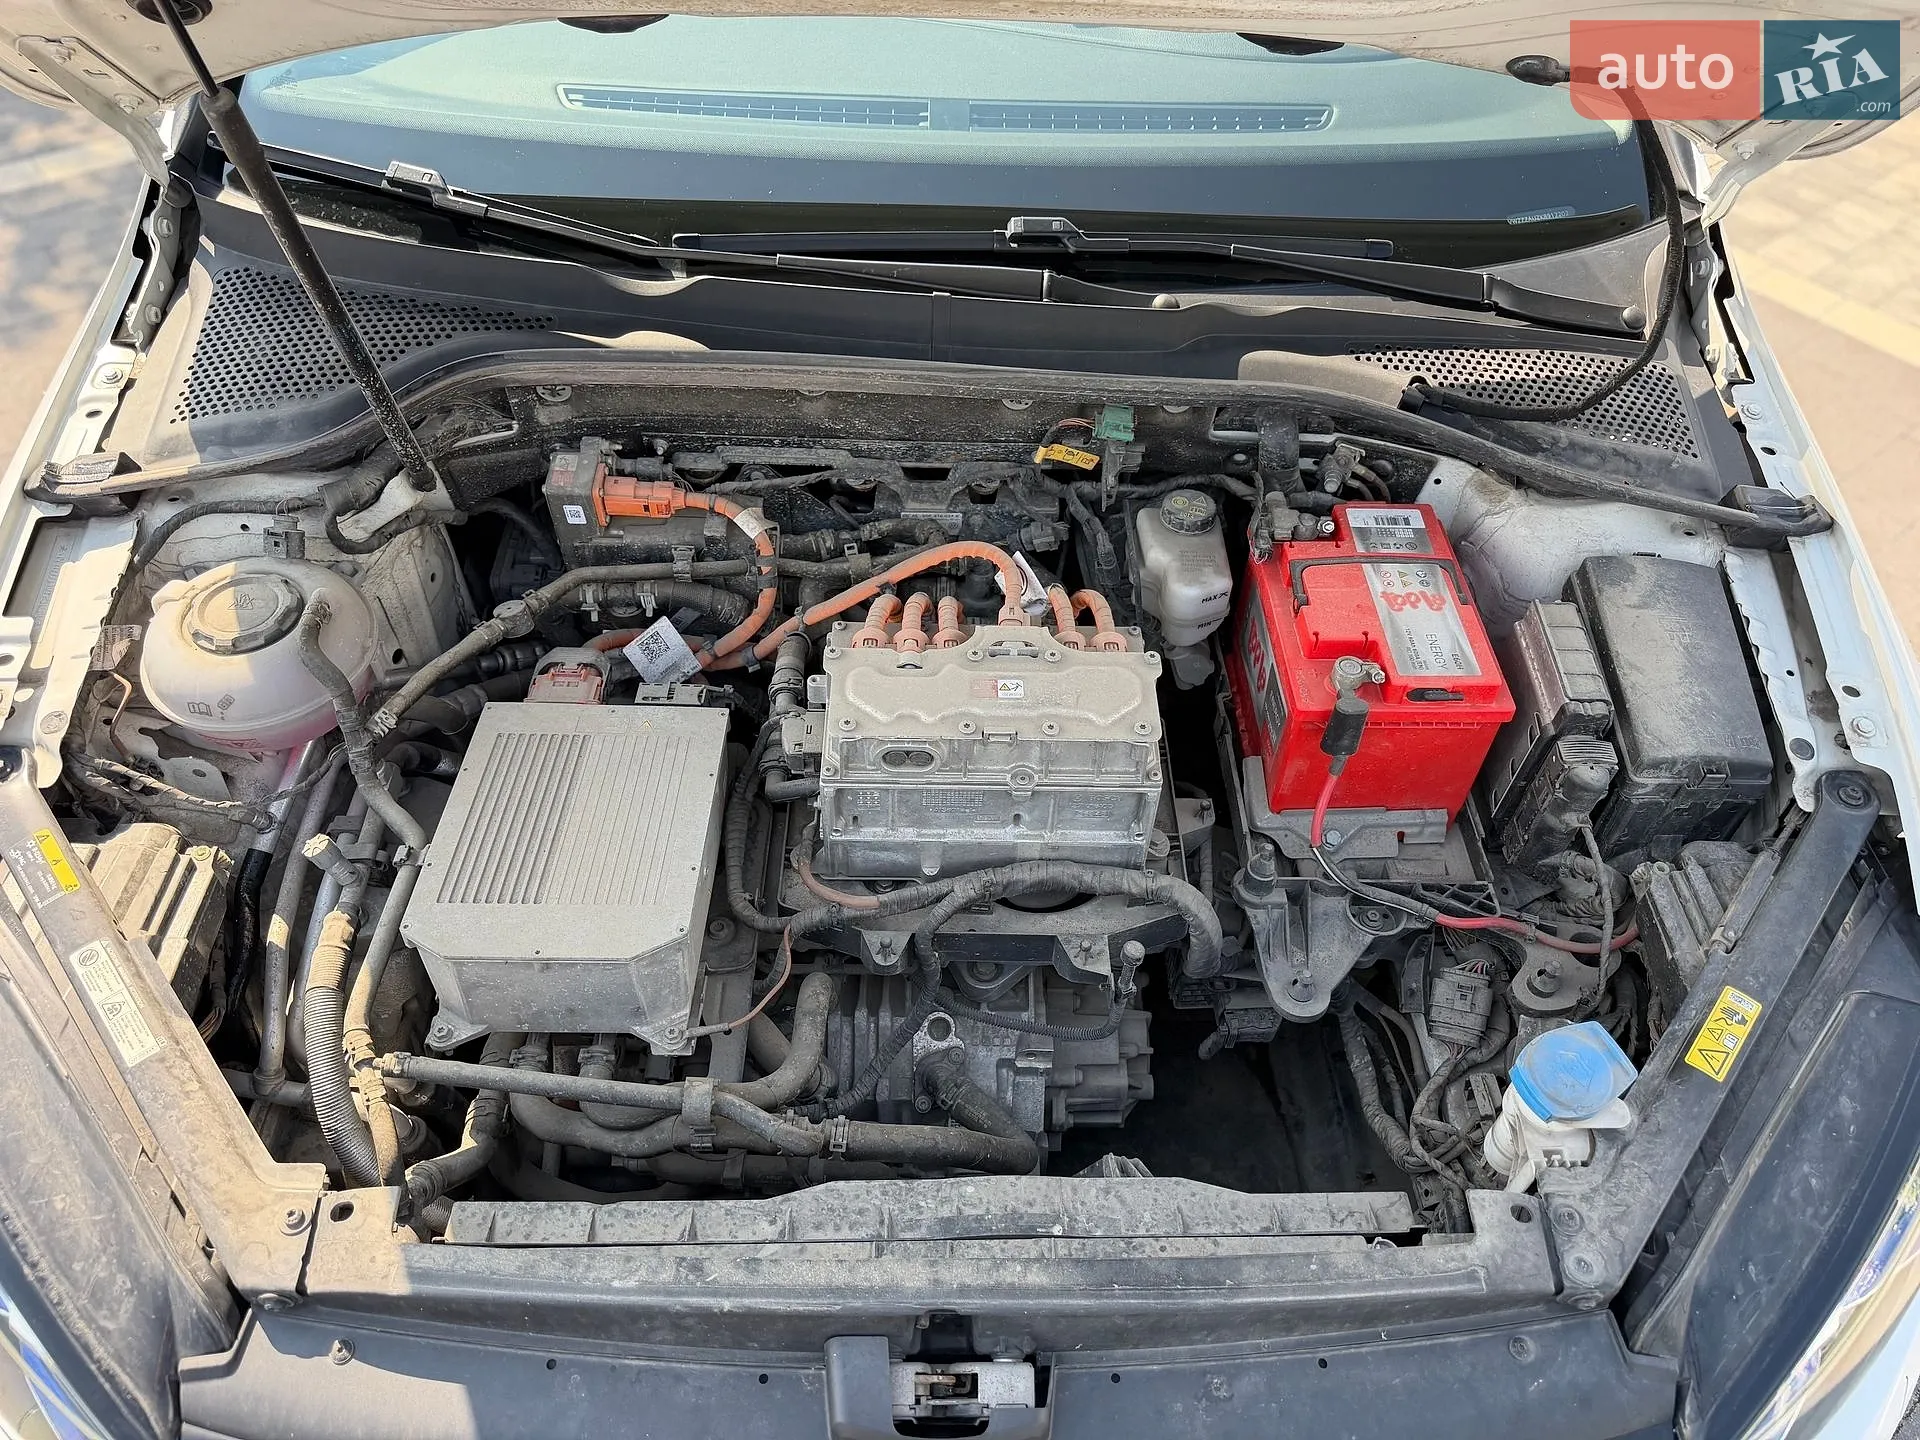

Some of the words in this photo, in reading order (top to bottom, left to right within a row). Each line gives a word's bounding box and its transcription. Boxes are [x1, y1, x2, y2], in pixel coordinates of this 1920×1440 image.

[1201, 594, 1219, 604] MAX
[1197, 621, 1211, 630] MIN
[1425, 633, 1449, 670] ENERGY
